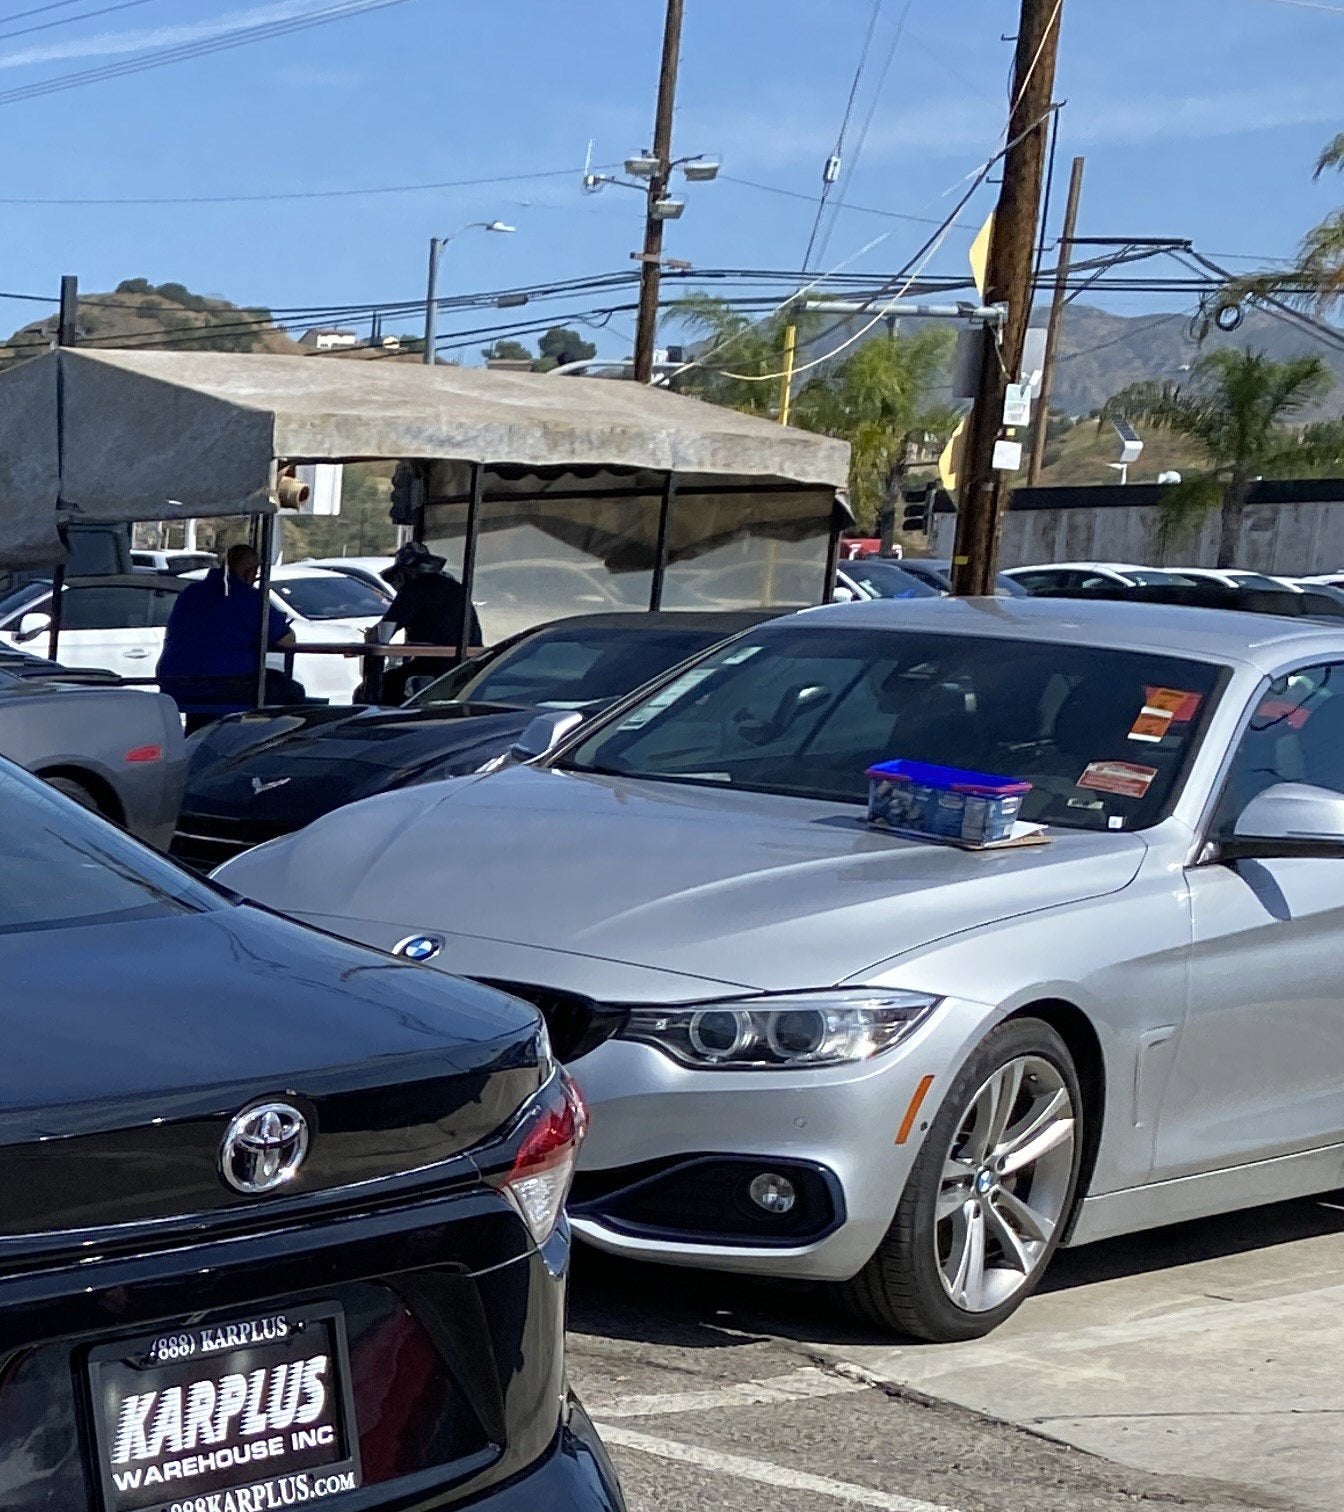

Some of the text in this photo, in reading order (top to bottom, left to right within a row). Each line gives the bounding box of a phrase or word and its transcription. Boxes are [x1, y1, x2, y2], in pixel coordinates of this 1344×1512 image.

[150, 1315, 290, 1361] (888) KARPLUS
[110, 1354, 329, 1465] KARPLUS
[112, 1424, 335, 1492] WAREHOUSE INC
